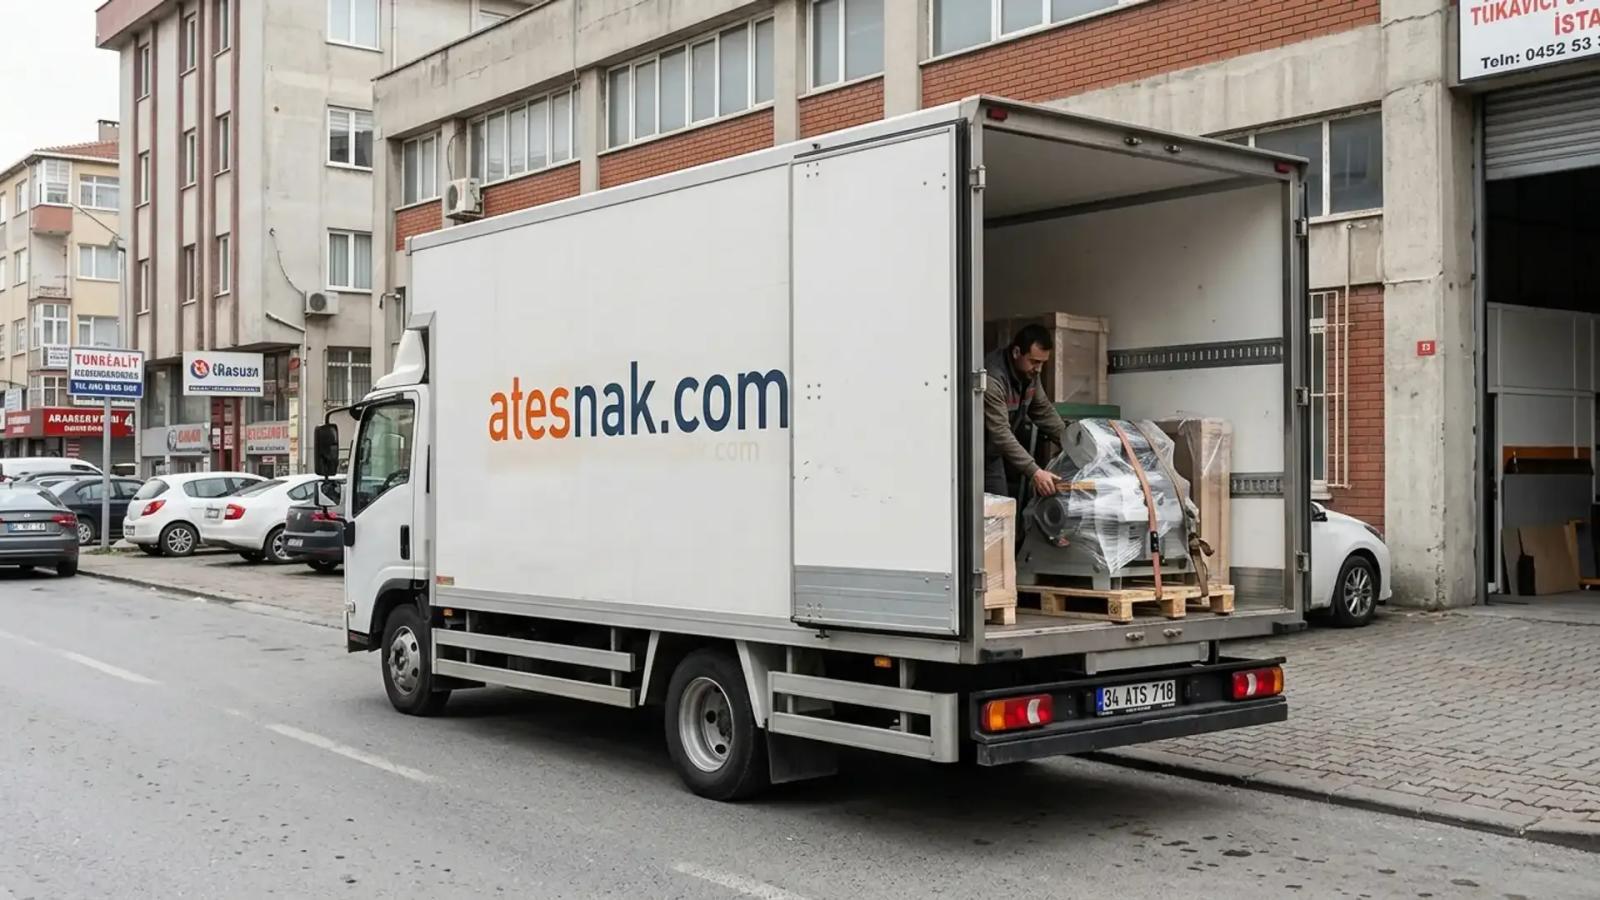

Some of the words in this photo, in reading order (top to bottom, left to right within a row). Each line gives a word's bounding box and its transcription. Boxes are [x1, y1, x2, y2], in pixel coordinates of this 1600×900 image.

[1525, 42, 1566, 61] 0452
[1571, 37, 1592, 52] 53
[488, 361, 789, 442] atesnak.com
[1104, 688, 1119, 708] 34
[1125, 685, 1147, 705] ATS
[1152, 682, 1173, 702] 718
